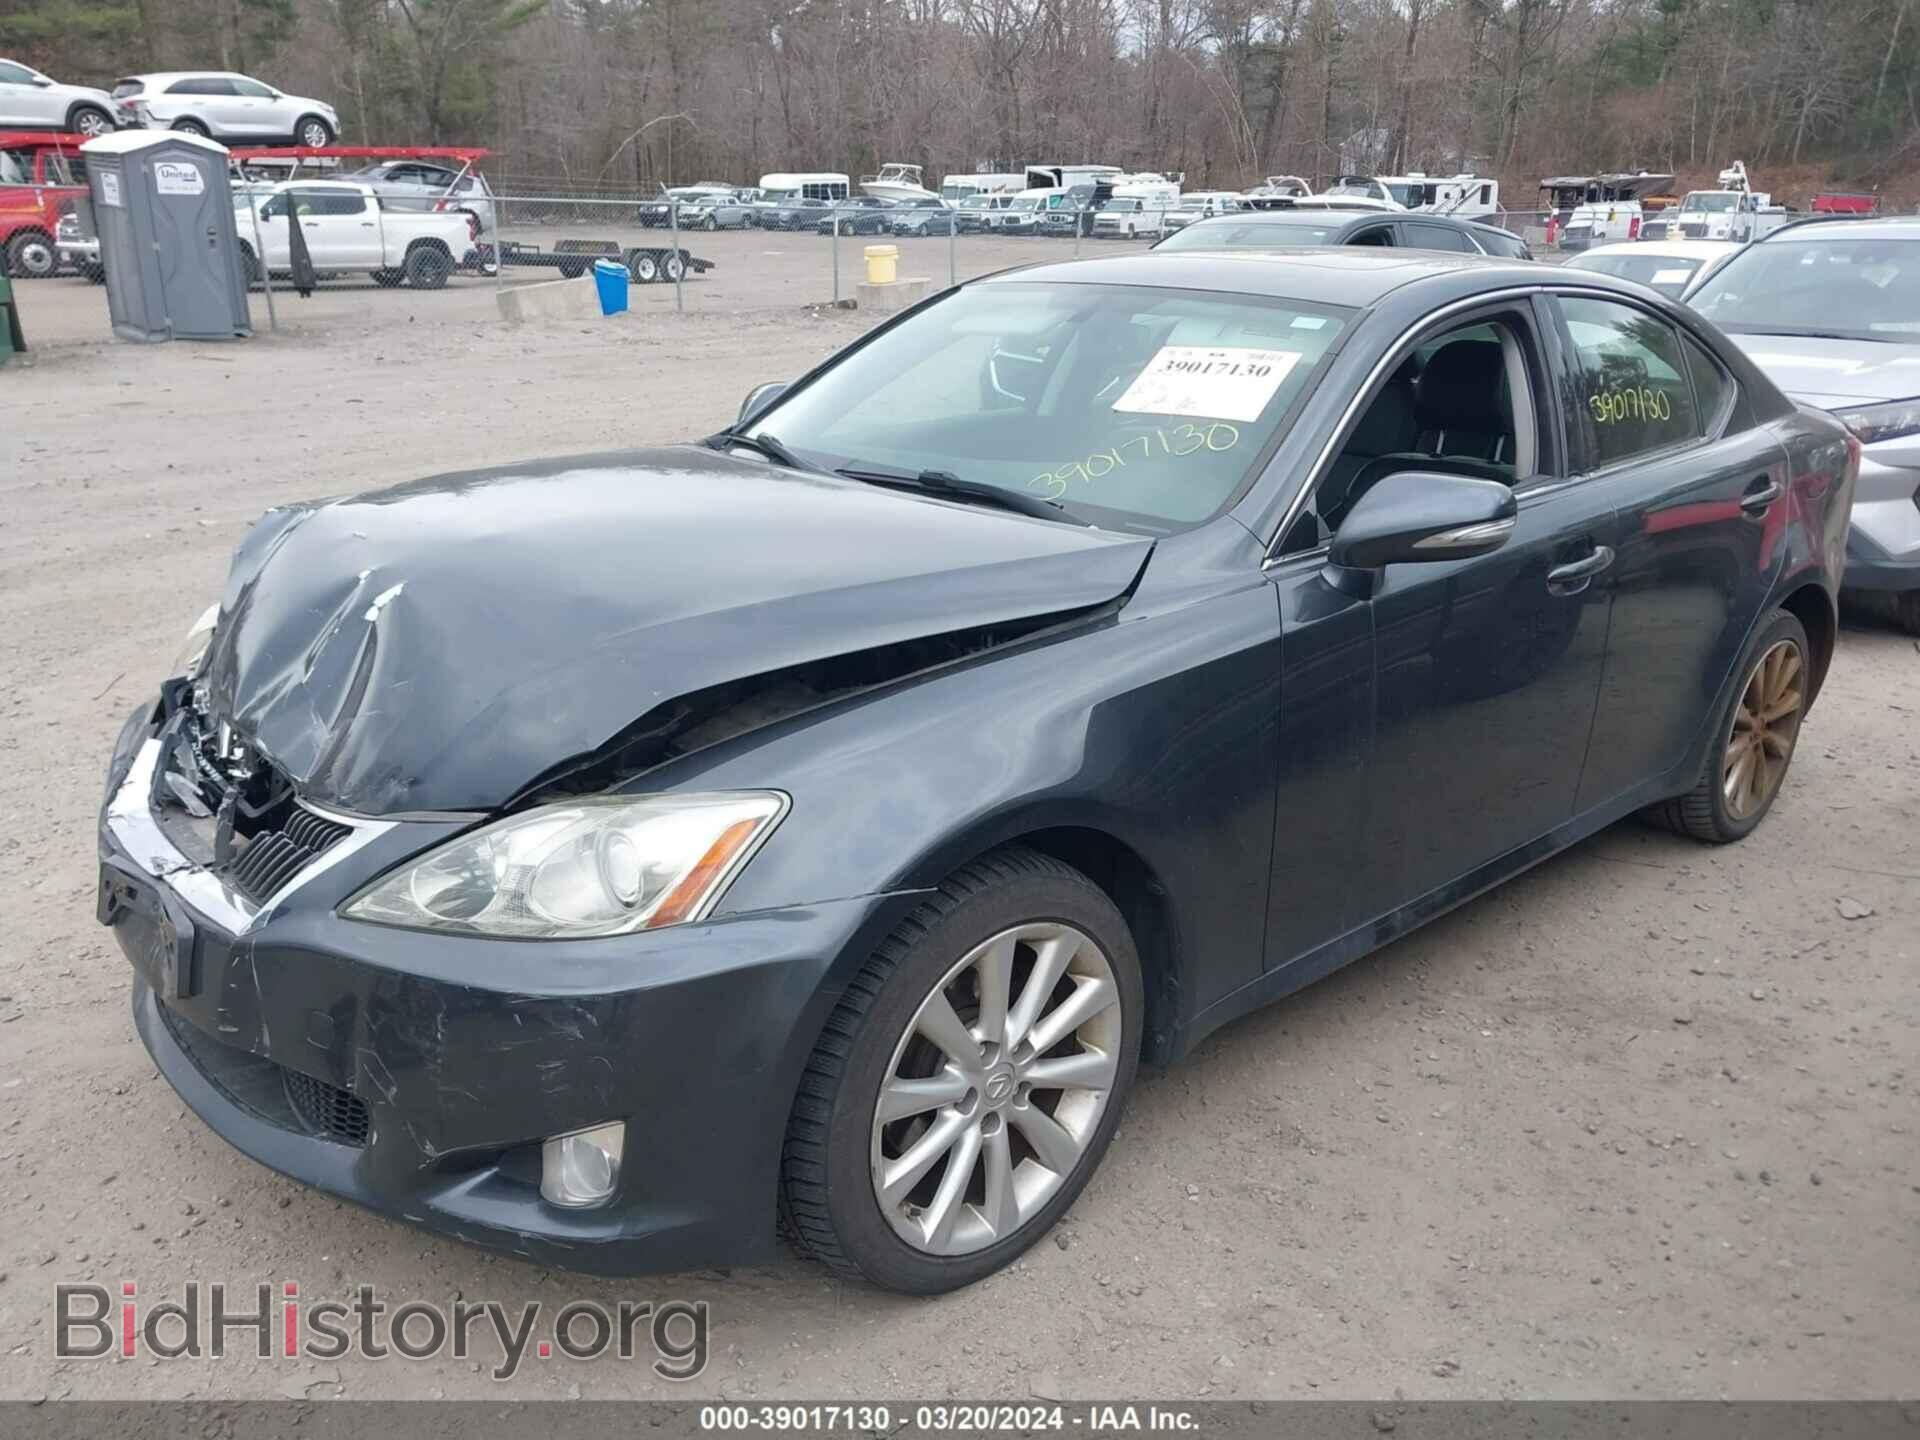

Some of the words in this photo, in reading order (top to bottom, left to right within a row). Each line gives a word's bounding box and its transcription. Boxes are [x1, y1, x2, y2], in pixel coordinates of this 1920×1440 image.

[160, 169, 197, 179] United
[1160, 360, 1272, 377] 39017130
[1589, 385, 1671, 424] 39017130
[1028, 423, 1239, 501] 39017130
